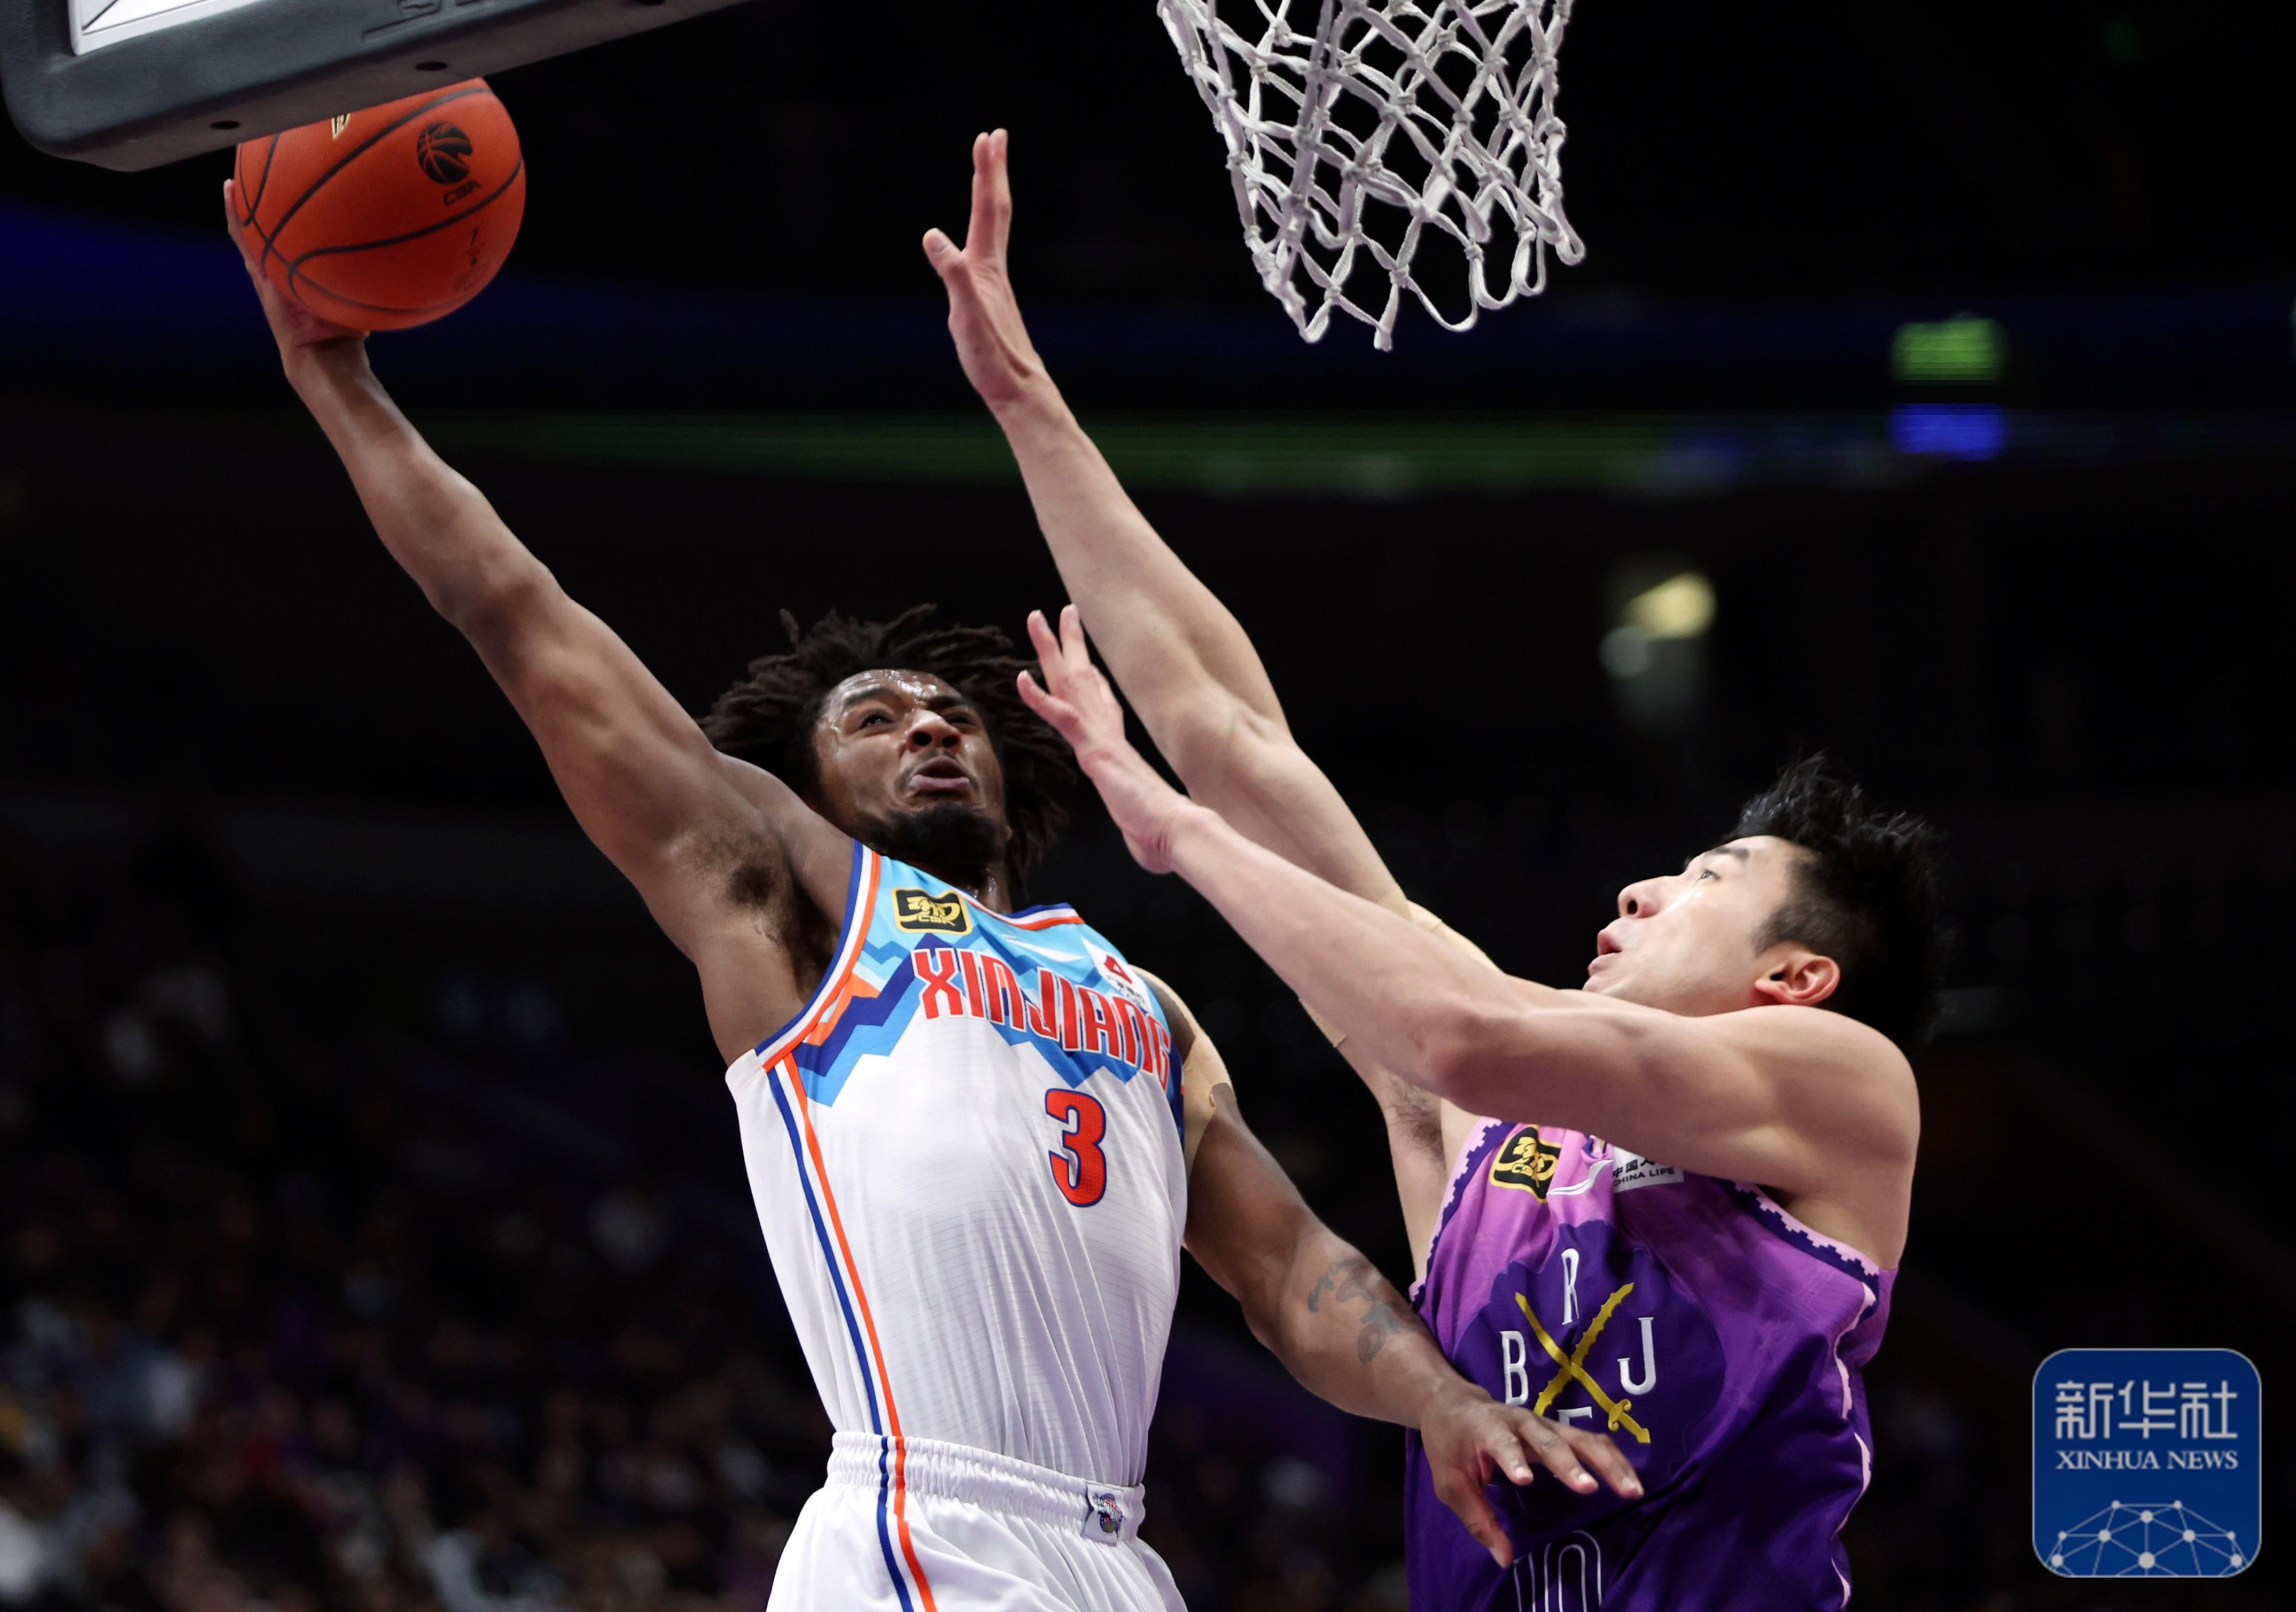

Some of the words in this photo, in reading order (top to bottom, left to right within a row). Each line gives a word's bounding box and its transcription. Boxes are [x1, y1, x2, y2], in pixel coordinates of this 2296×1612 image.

[909, 947, 1172, 1092] XINJIANG
[1044, 1088, 1107, 1207] 3
[1613, 1172, 1646, 1187] CHINA
[1649, 1167, 1675, 1177] LIFE
[1561, 1247, 1579, 1326] R
[1499, 1330, 1529, 1406] B
[1617, 1317, 1656, 1396] J
